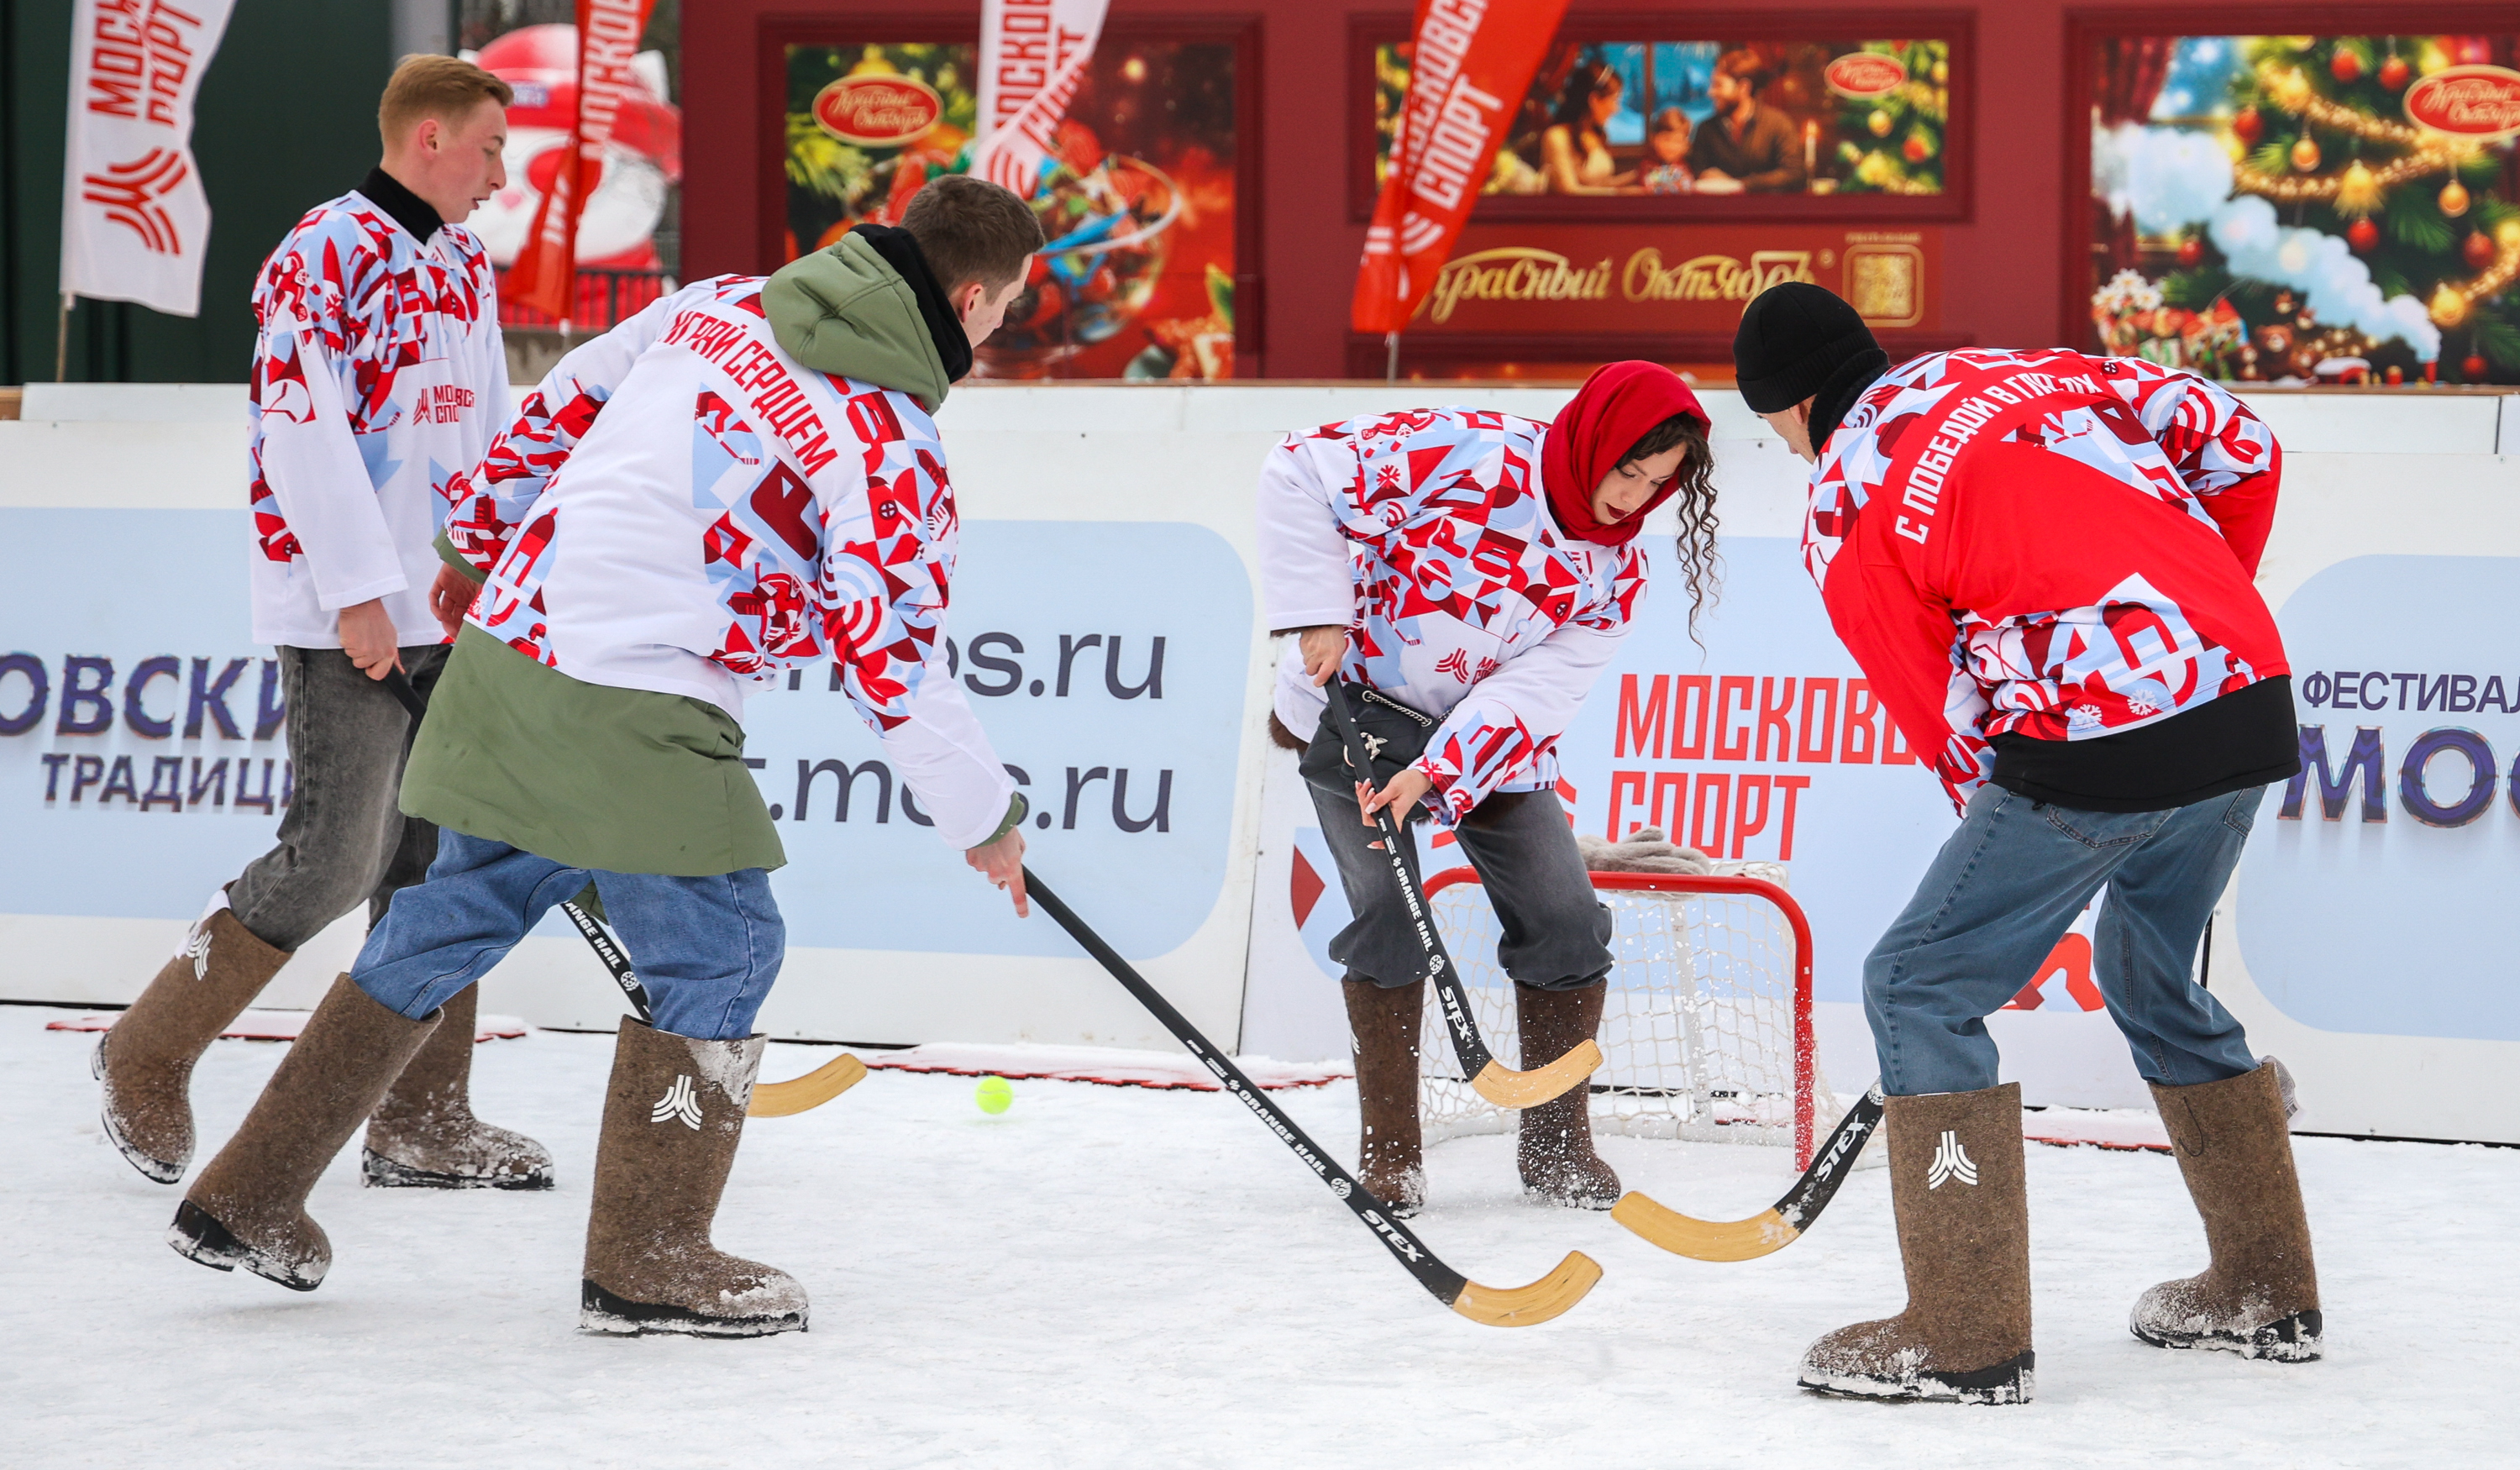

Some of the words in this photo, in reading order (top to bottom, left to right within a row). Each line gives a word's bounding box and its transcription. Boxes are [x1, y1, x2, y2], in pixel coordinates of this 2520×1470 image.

[1413, 73, 1504, 212] СПОРТ
[662, 310, 748, 364] ИГРАЙ
[722, 339, 838, 479] СЕРДЦЕМ
[1982, 386, 2022, 405] В
[1903, 396, 2003, 516] ПОБЕДОЙ
[1895, 515, 1929, 544] С
[41, 753, 296, 815] ТРАДИЦ
[2276, 723, 2520, 828] МО
[1606, 770, 1811, 861] СПОРТ
[564, 900, 598, 937] ANGE
[593, 937, 622, 969] HAIL
[1395, 867, 1422, 921] ORANGE
[1416, 920, 1433, 952] HAIL
[1441, 985, 1472, 1040] STEX
[1238, 1089, 1296, 1144] ORANGE
[1294, 1142, 1328, 1176] HAIL
[1817, 1113, 1866, 1182] STEX
[1361, 1209, 1425, 1263] STEX
